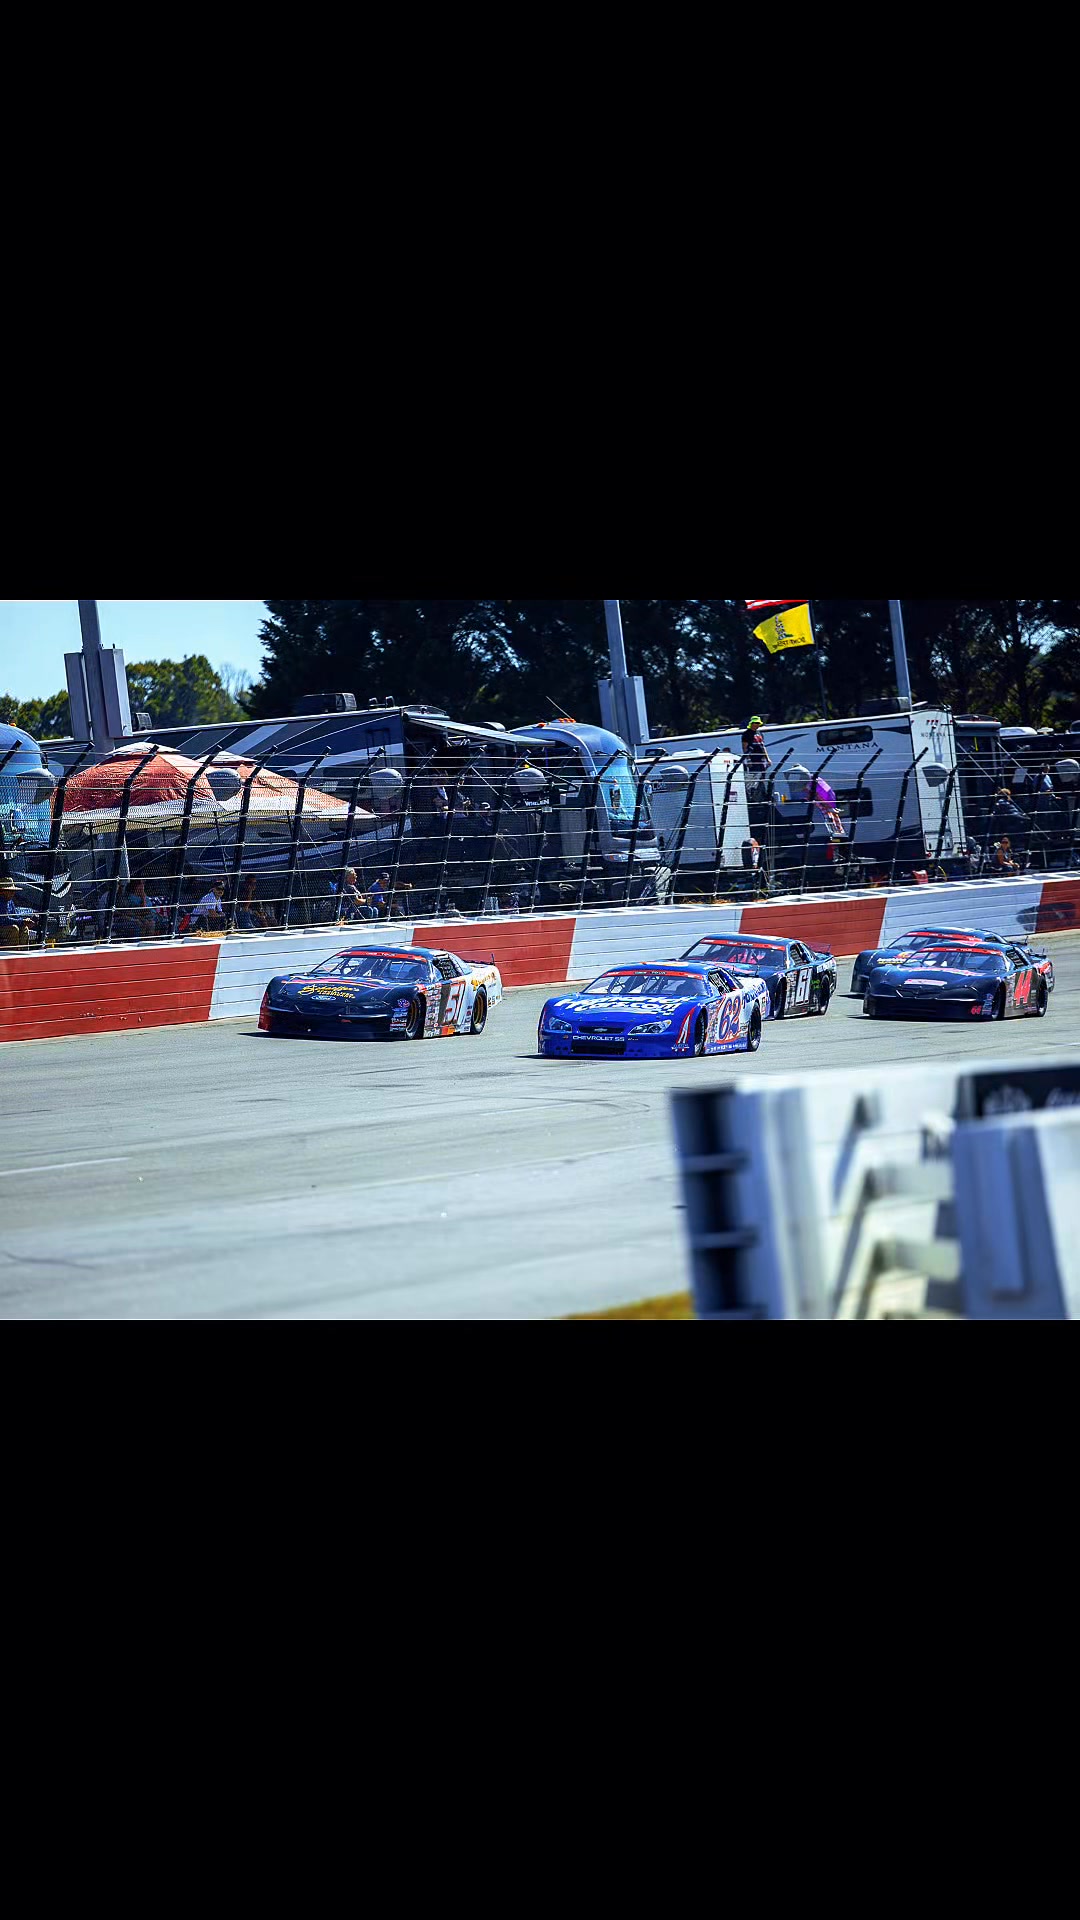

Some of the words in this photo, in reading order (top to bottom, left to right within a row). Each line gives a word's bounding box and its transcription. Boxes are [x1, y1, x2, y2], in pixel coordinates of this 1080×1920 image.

[816, 742, 879, 753] MONTANA
[1014, 969, 1033, 1006] 44
[718, 995, 741, 1041] 62
